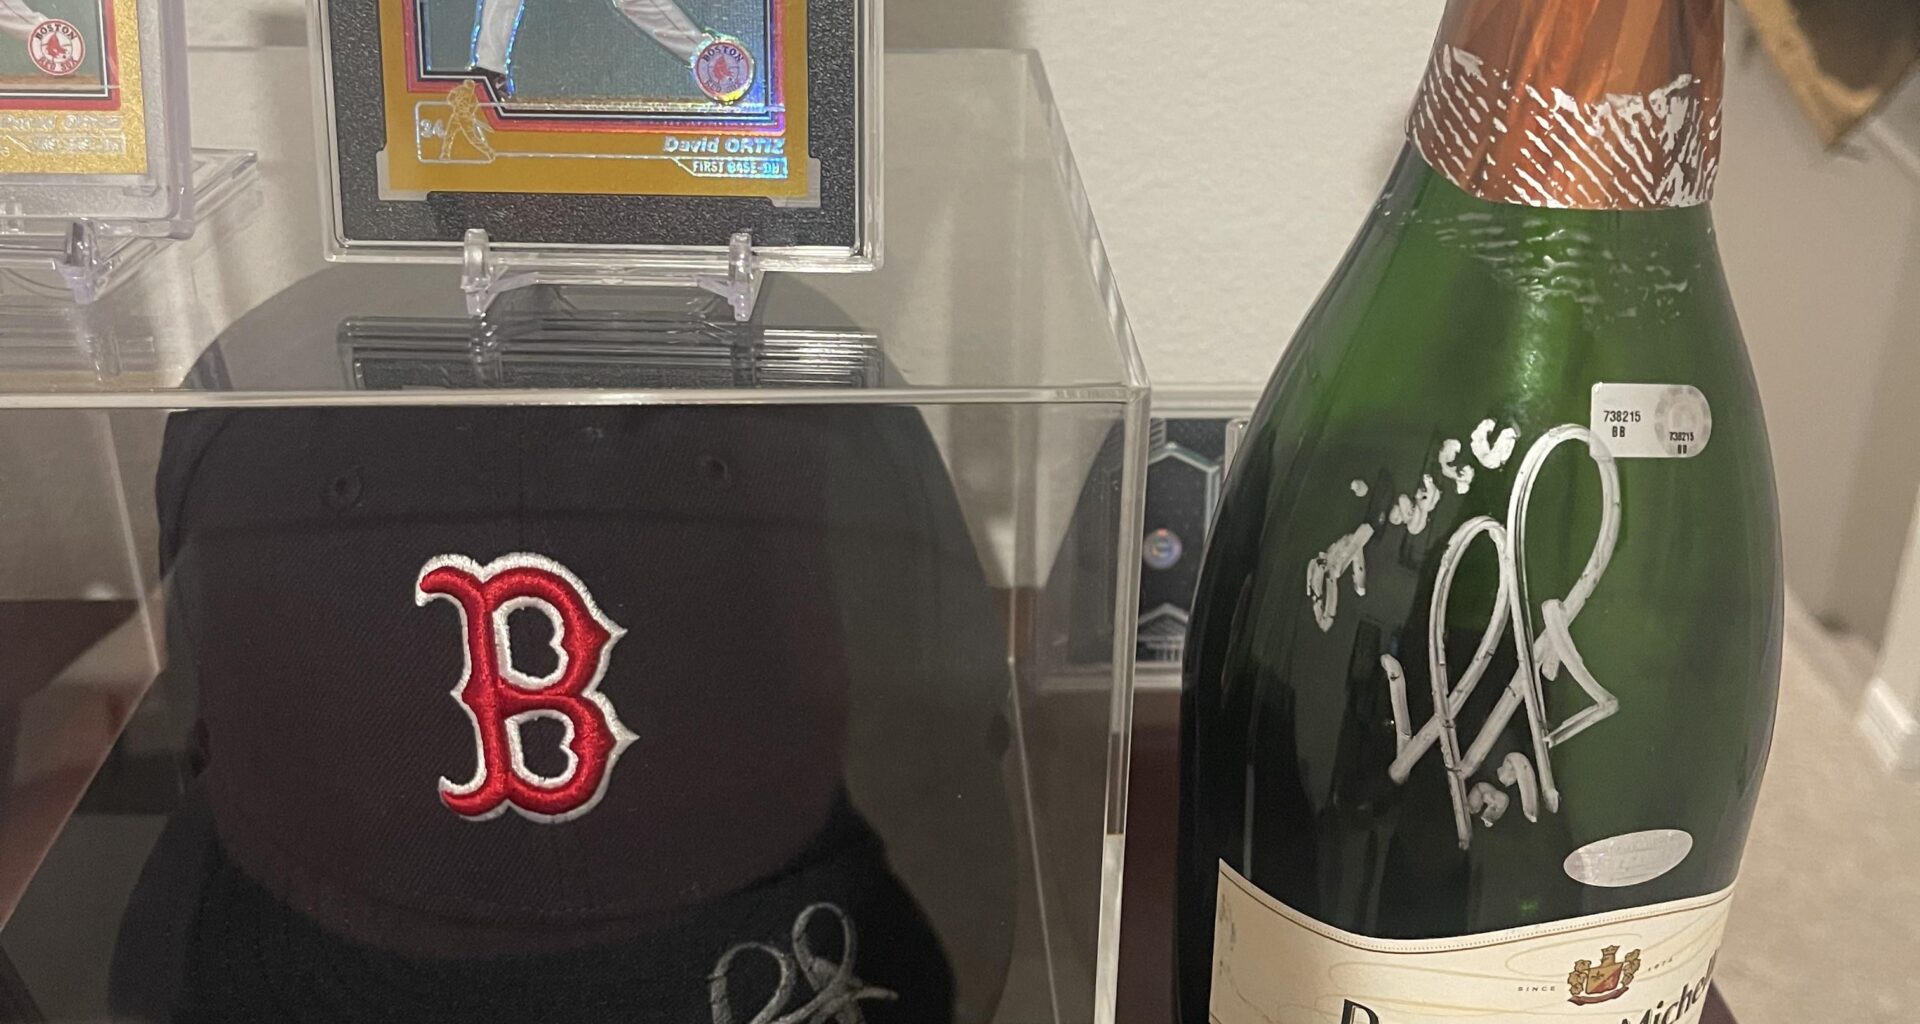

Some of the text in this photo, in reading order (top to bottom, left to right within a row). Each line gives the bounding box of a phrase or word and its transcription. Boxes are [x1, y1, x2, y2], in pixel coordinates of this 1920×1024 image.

[36, 23, 77, 40] BOSTON
[703, 45, 744, 62] BOSTON
[663, 136, 785, 154] David ORTIZ
[692, 160, 780, 174] FIRST BASE-DH
[1603, 410, 1641, 422] 738215
[415, 552, 641, 824] B
